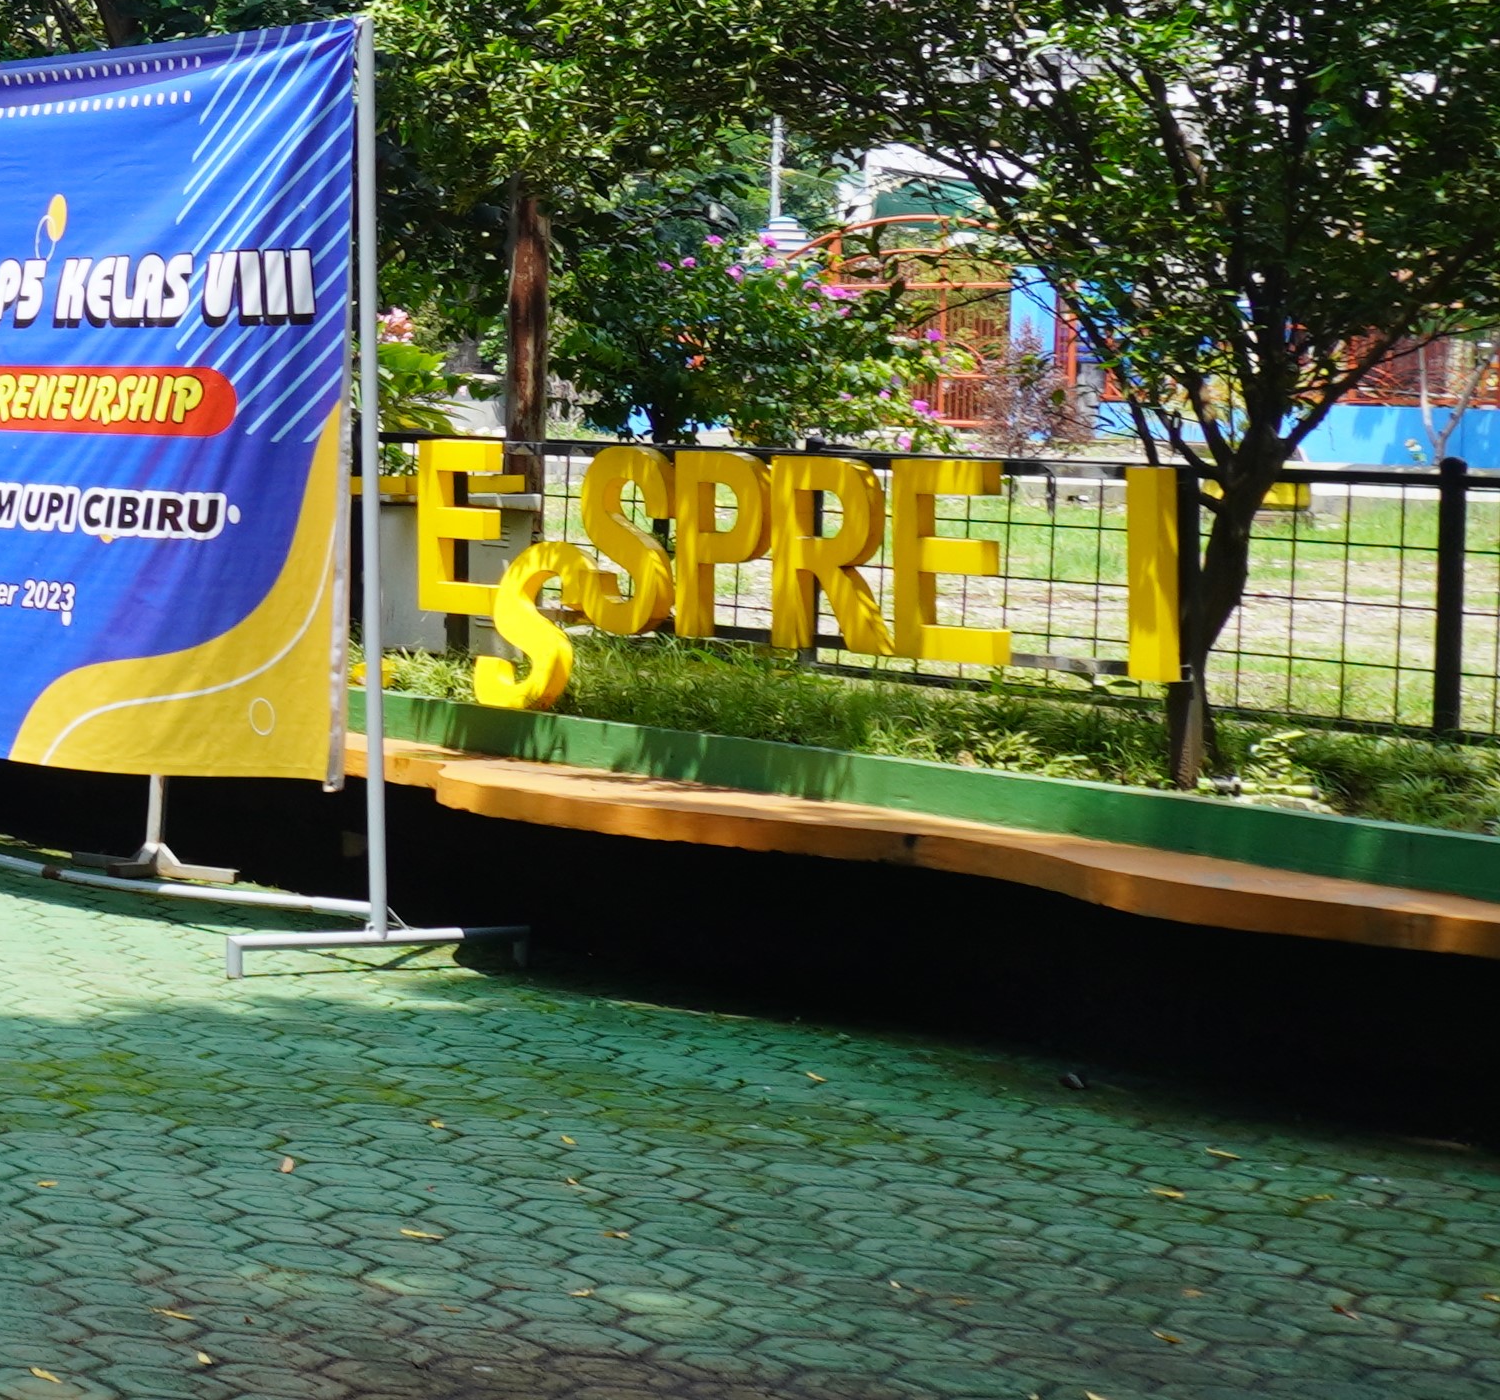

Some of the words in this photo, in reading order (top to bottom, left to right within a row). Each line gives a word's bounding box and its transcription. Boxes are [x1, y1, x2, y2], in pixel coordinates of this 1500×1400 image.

[53, 252, 193, 328] KELAS
[202, 247, 317, 328] VIII
[22, 488, 77, 529] UPI
[82, 491, 222, 536] CIBIRU
[20, 579, 77, 612] 2023
